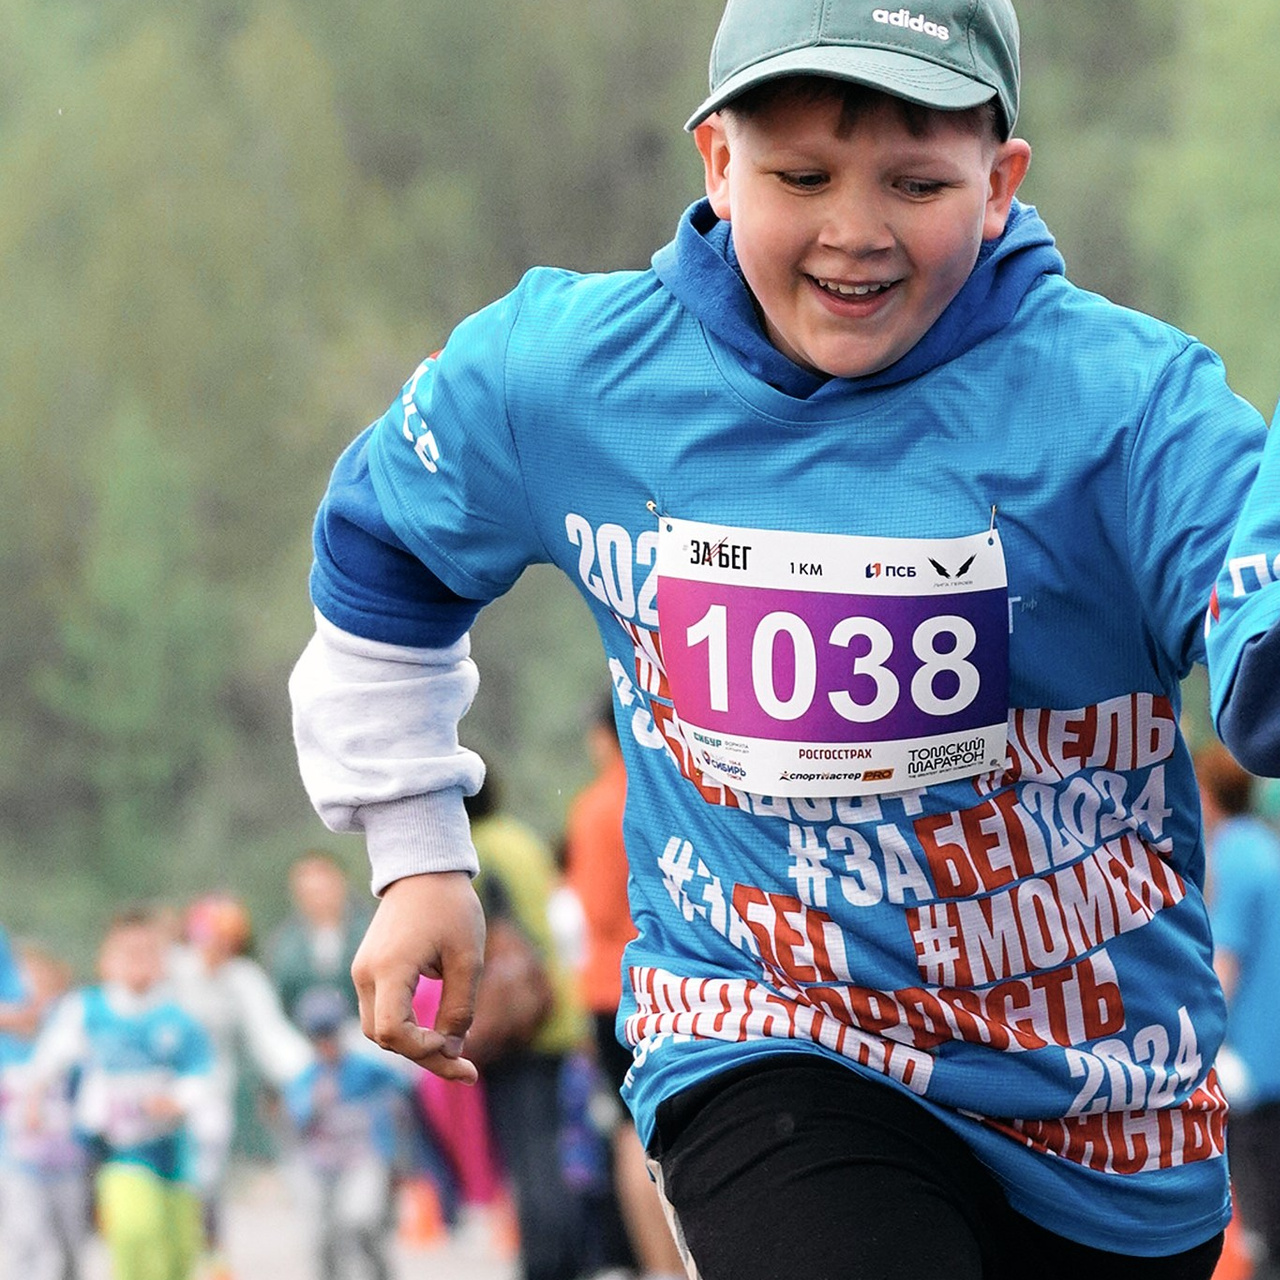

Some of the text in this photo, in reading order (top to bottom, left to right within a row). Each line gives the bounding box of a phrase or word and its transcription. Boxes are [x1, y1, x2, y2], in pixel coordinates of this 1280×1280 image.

[872, 8, 950, 41] adidas
[565, 512, 660, 628] 202
[885, 565, 917, 578] ПСБ
[686, 603, 981, 724] 1038
[798, 748, 872, 760] РОСГОССТРАХ
[907, 736, 986, 762] ТОМСКИЙ
[907, 749, 986, 775] МАРАФОН
[710, 759, 747, 777] СИБИРЬ
[864, 769, 894, 781] PRO
[1064, 1005, 1202, 1120] 2024
